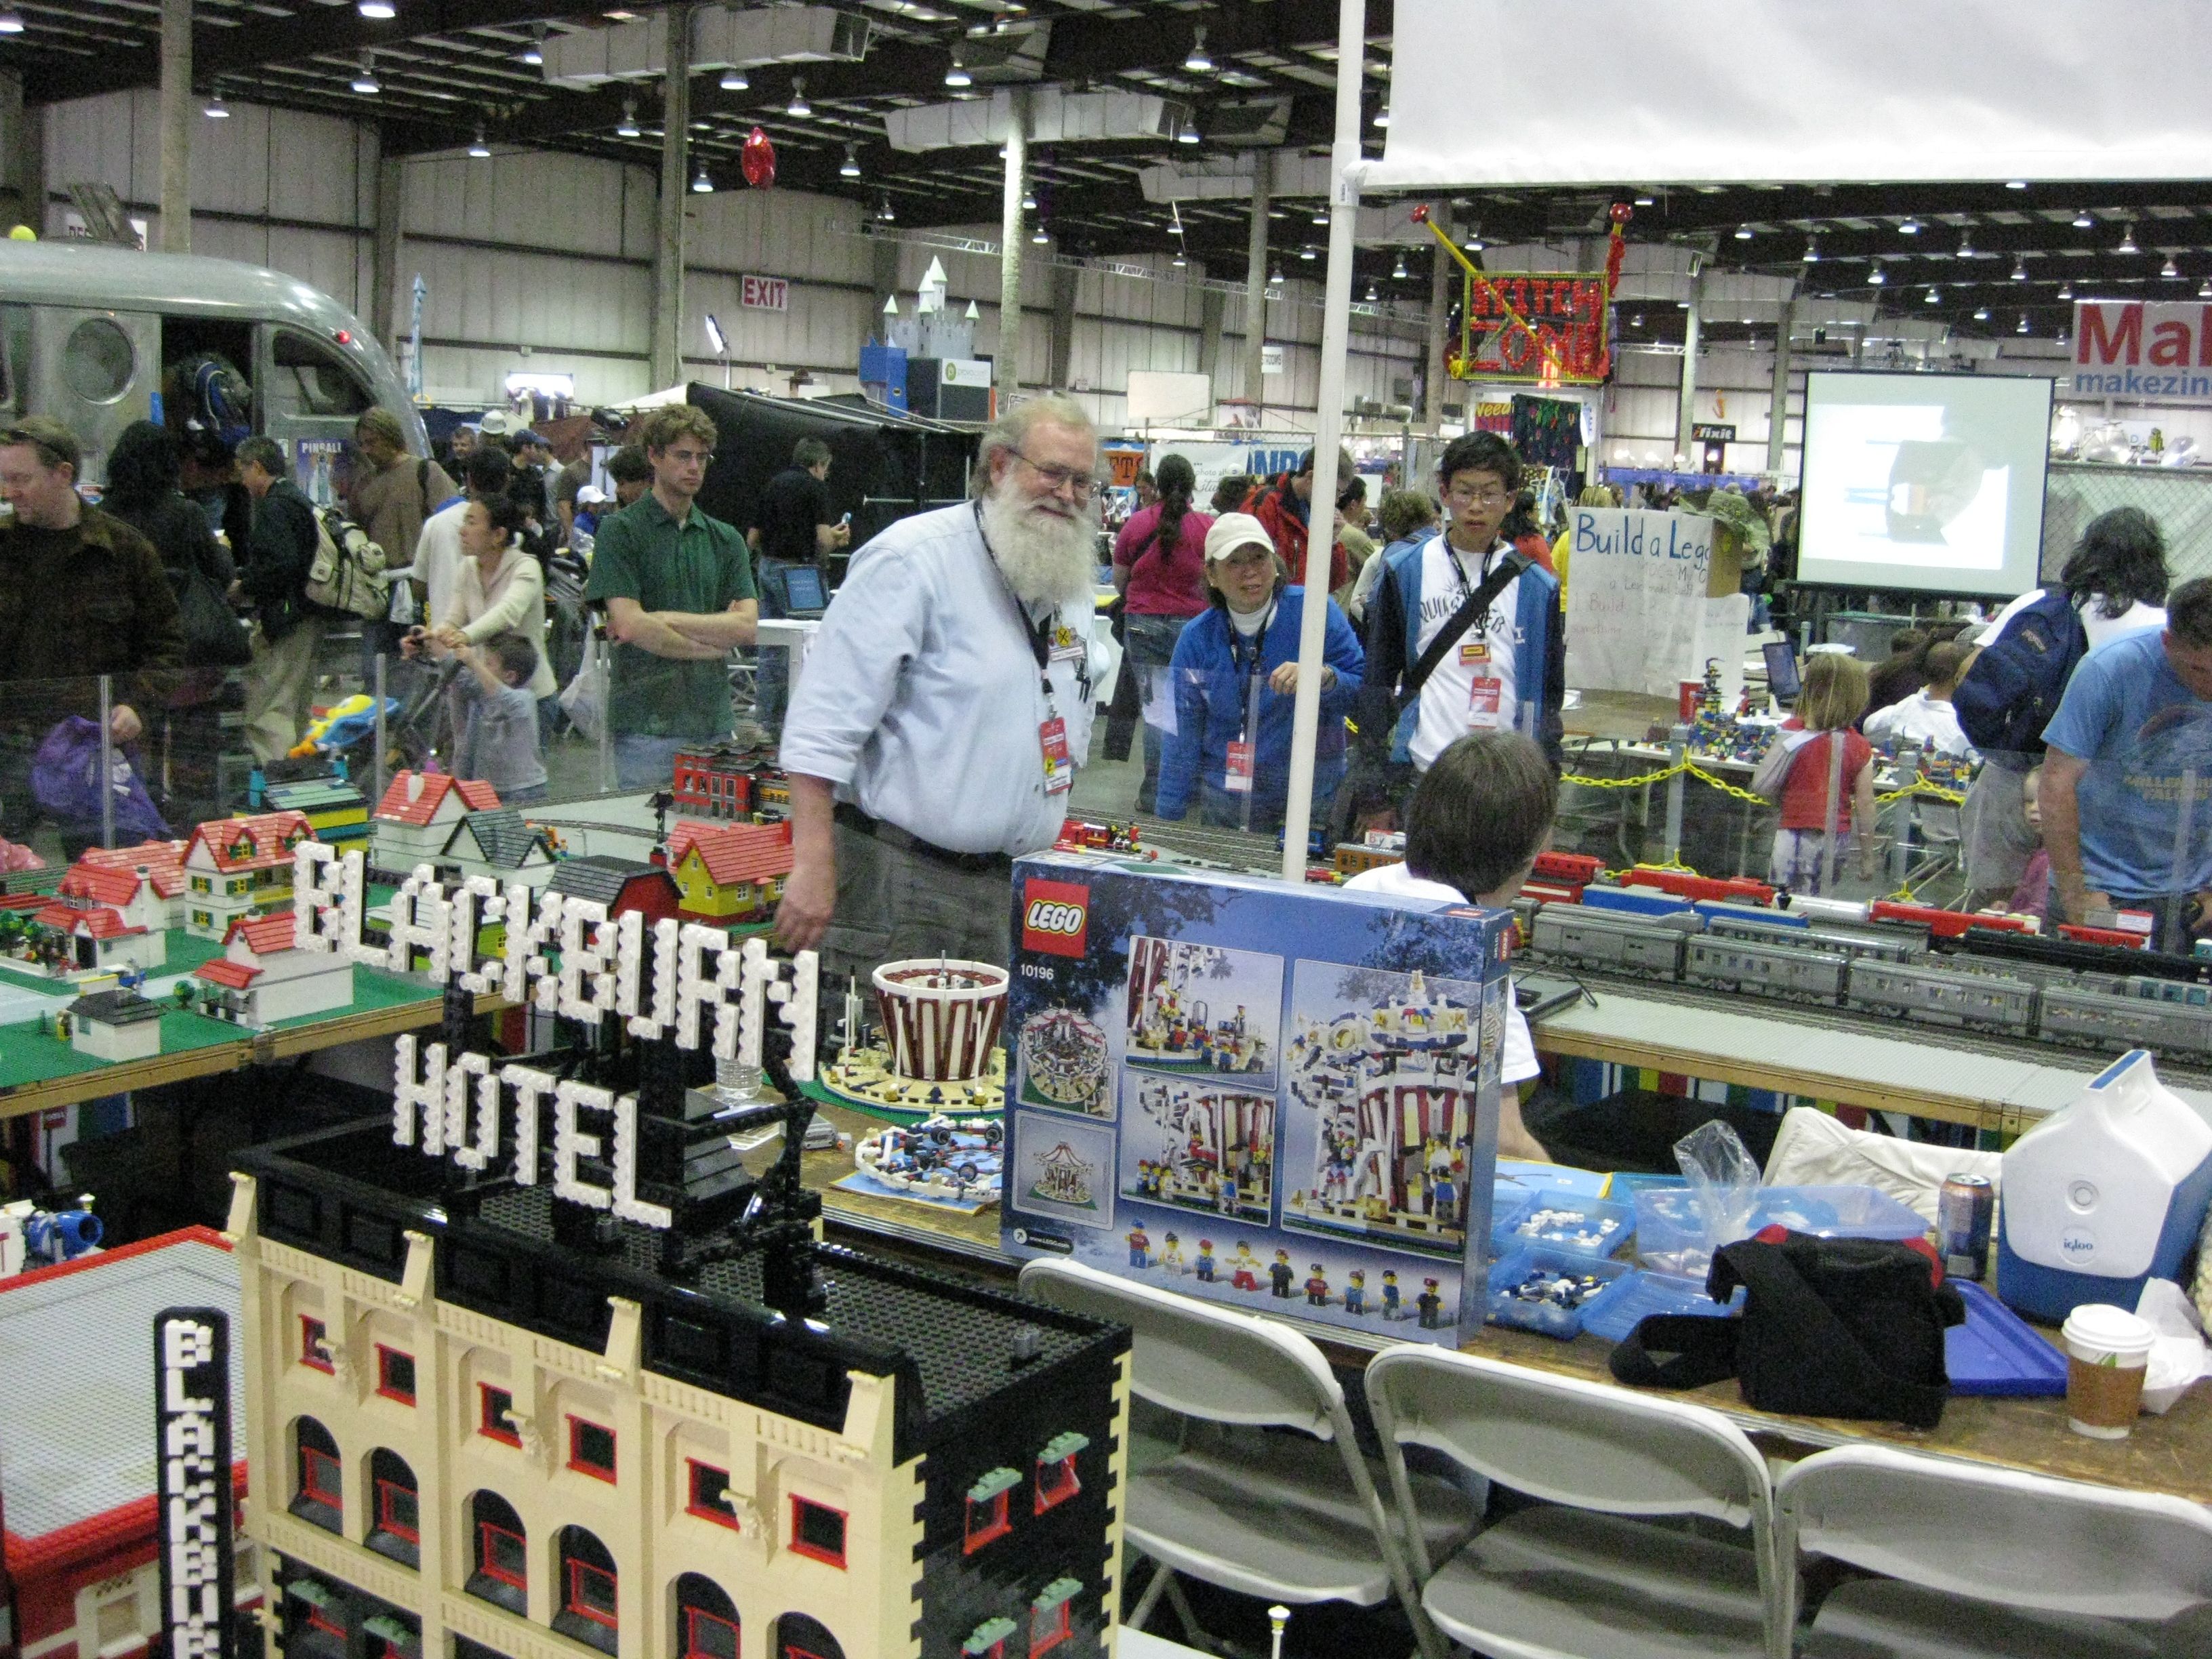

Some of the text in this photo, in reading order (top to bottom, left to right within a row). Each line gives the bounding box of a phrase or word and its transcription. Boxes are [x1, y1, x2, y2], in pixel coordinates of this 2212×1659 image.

[744, 278, 786, 308] EXIT
[2075, 368, 2212, 395] makezin
[1576, 513, 1644, 555] Build
[1650, 537, 1660, 557] a
[1027, 901, 1084, 935] LEGO
[293, 840, 819, 1082] BLACKBURN
[1021, 964, 1054, 981] 10196
[393, 1033, 672, 1229] HOTEL
[2063, 1238, 2093, 1252] igloo
